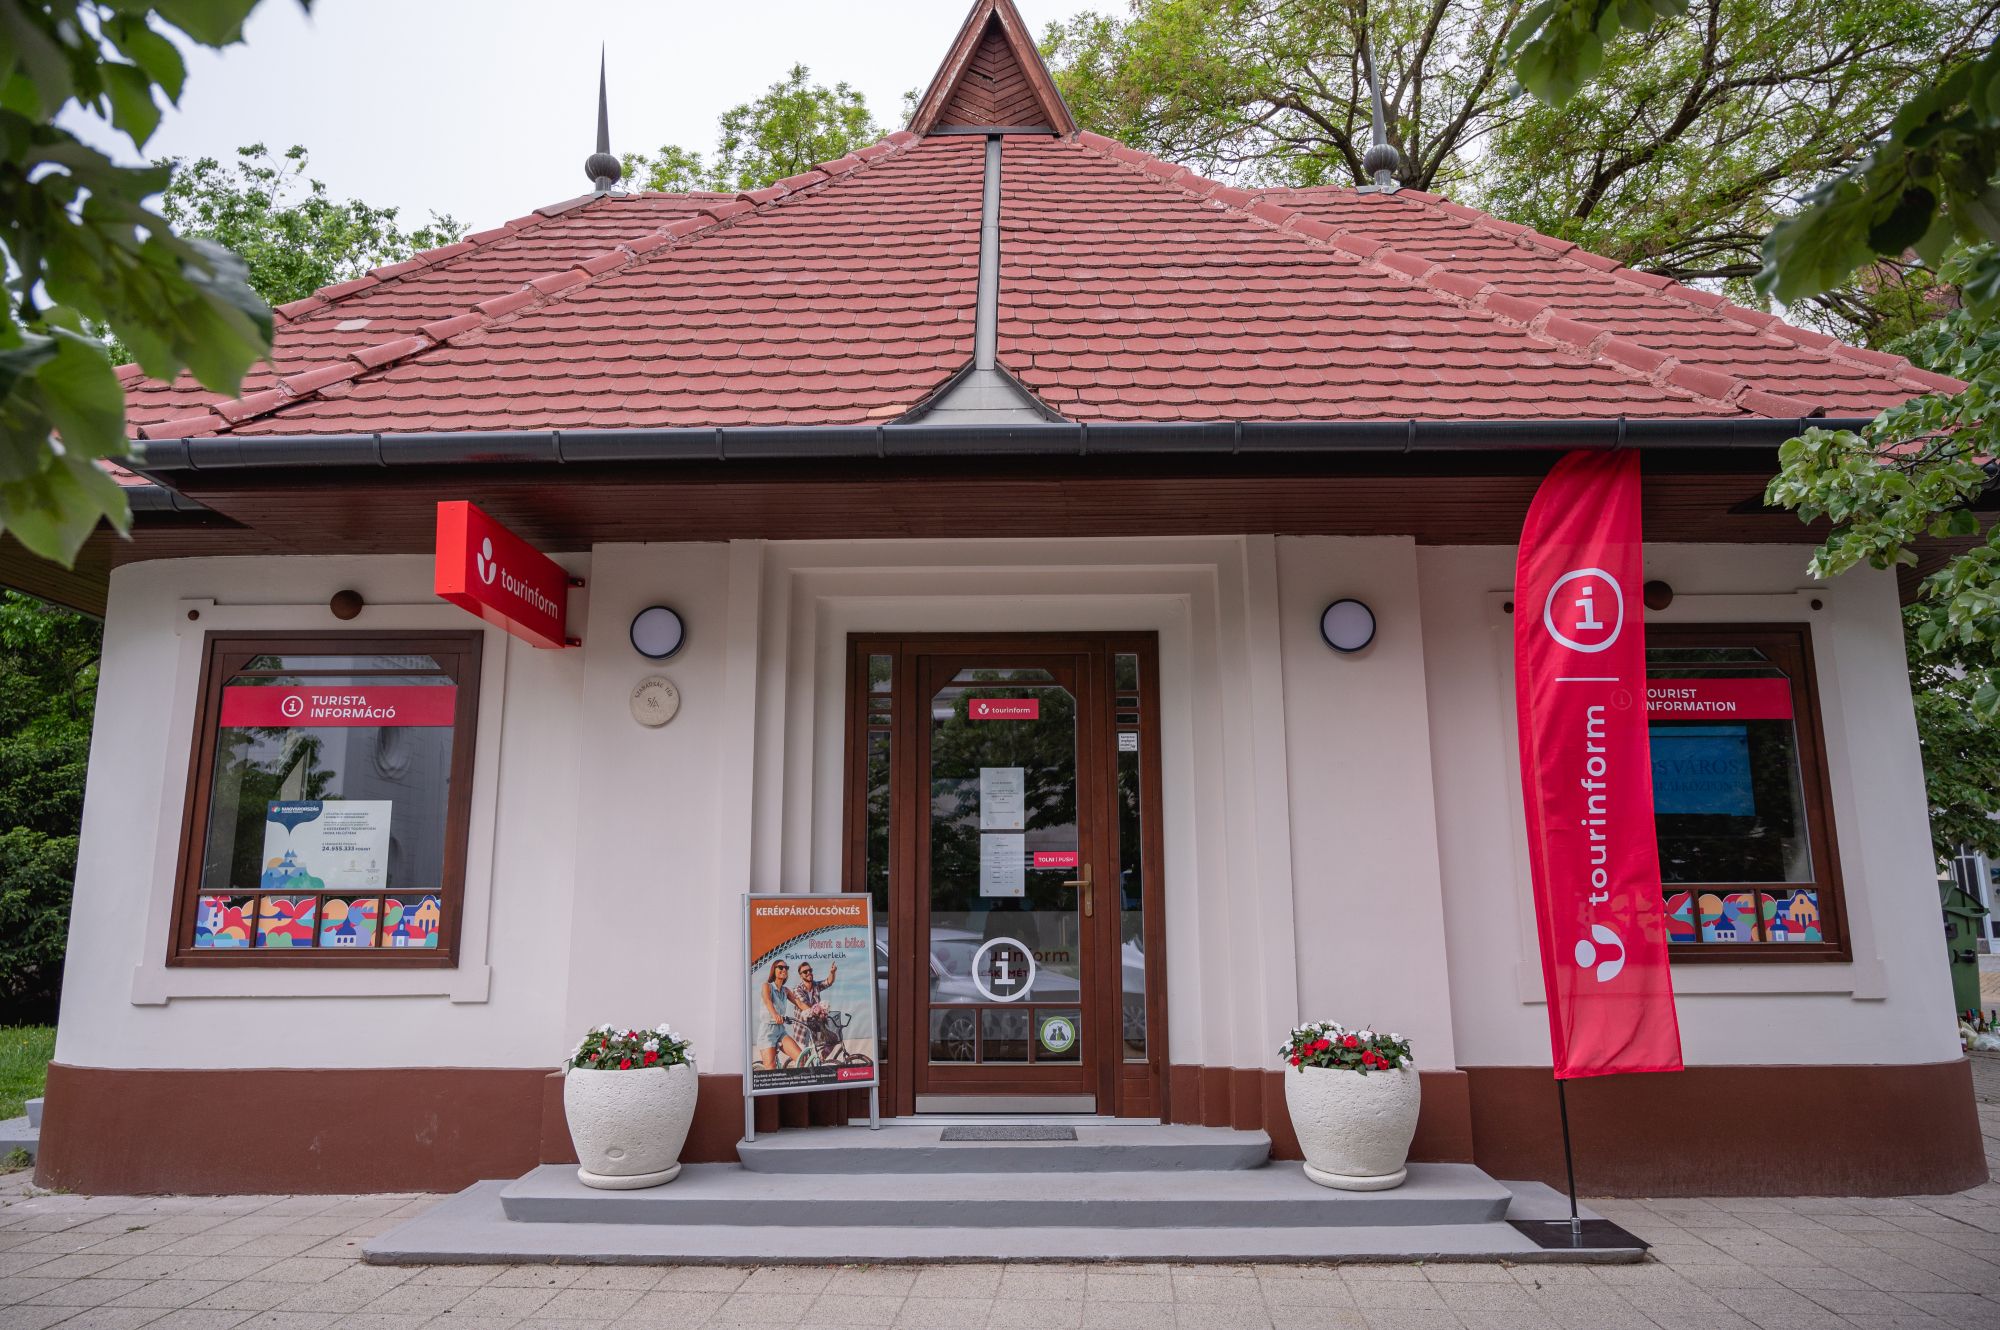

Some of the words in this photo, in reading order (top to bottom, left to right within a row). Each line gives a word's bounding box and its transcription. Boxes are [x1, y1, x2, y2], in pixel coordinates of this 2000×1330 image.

[501, 567, 558, 620] tourinform
[311, 695, 367, 706] TURISTA
[310, 705, 396, 719] INFORMÁCIÓ
[991, 706, 1031, 714] tourinform
[1581, 704, 1609, 907] tourinform
[756, 904, 861, 917] KERÉKPÁRKÖLCSÖNZÉS
[808, 938, 833, 950] Rent
[835, 940, 843, 949] a
[844, 937, 866, 949] bike
[785, 951, 847, 960] Fahrradverleih
